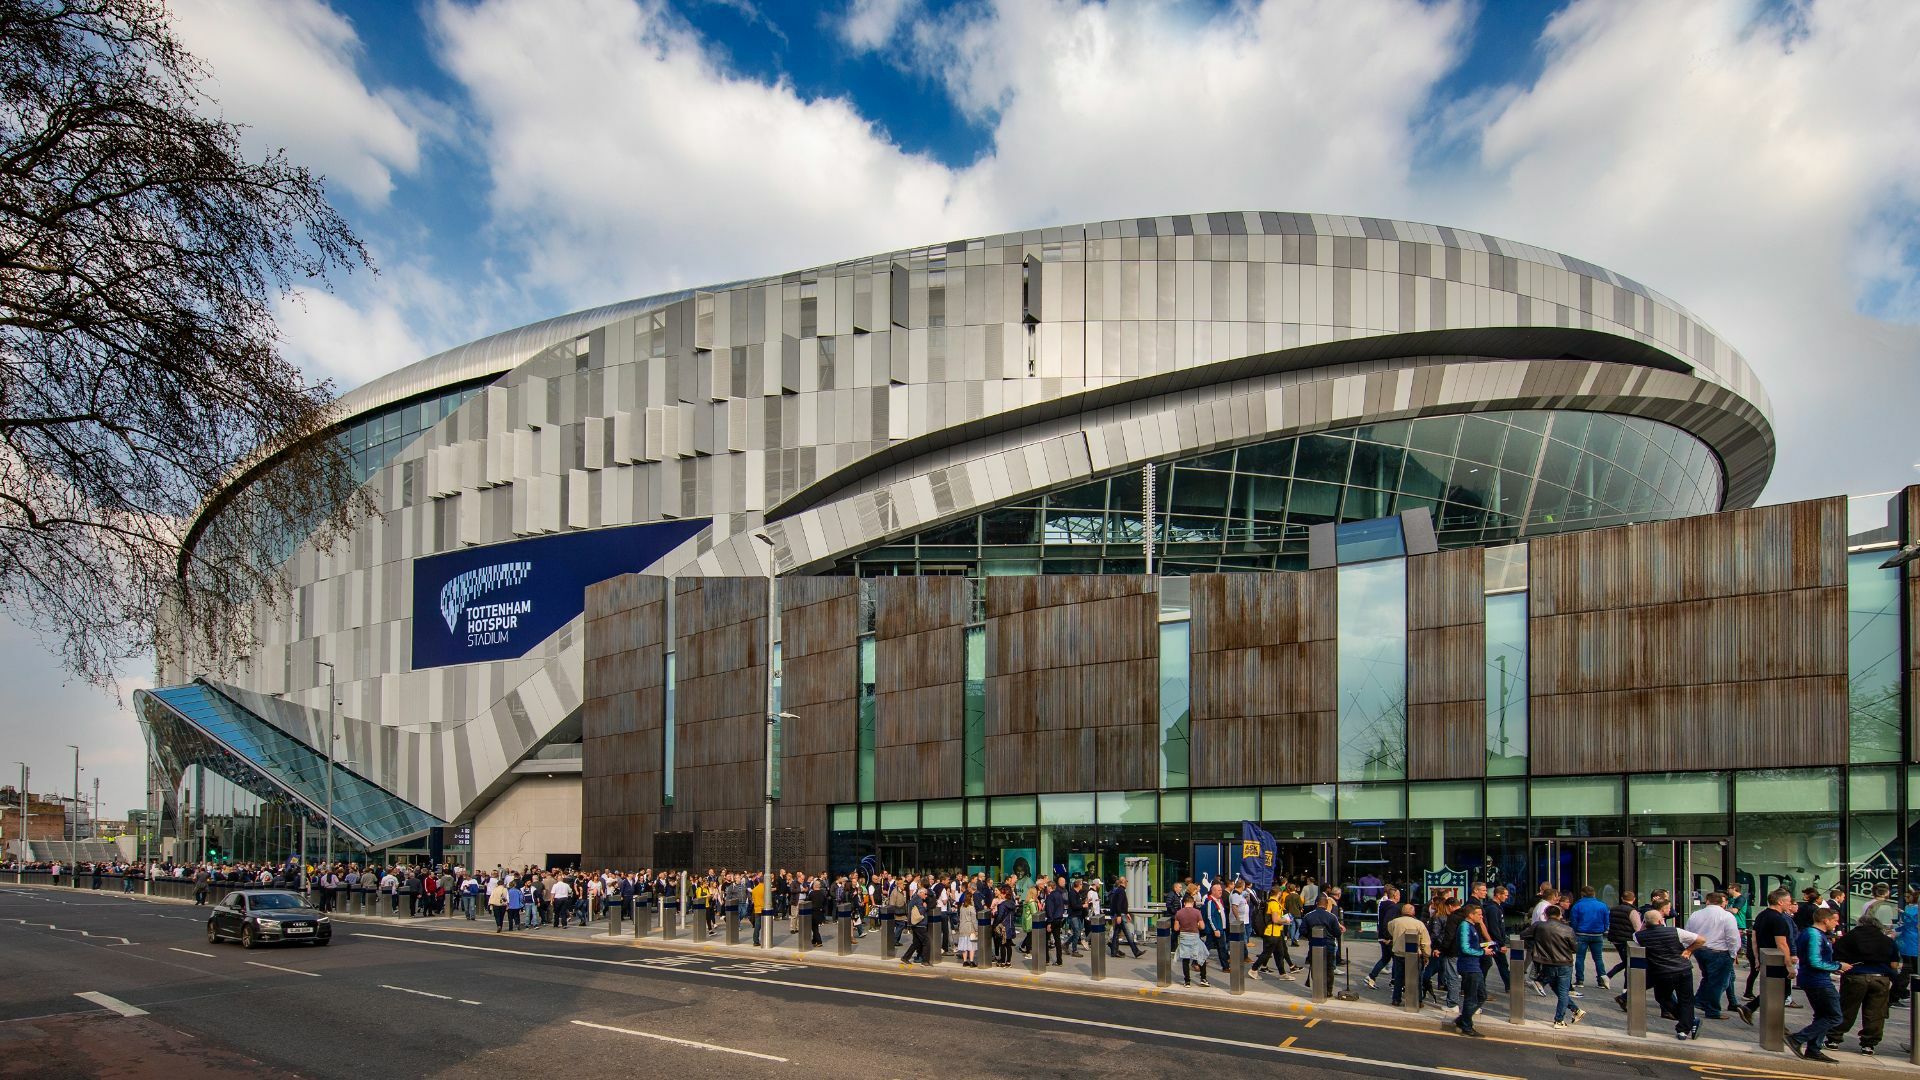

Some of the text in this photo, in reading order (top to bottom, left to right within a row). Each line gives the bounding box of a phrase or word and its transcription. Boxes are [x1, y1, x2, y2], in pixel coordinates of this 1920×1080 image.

[466, 600, 531, 620] TOTTENHAM
[467, 615, 518, 633] HOTSPUR
[467, 630, 509, 647] STADIUM
[1853, 868, 1898, 880] SINCE
[1851, 881, 1898, 898] 182
